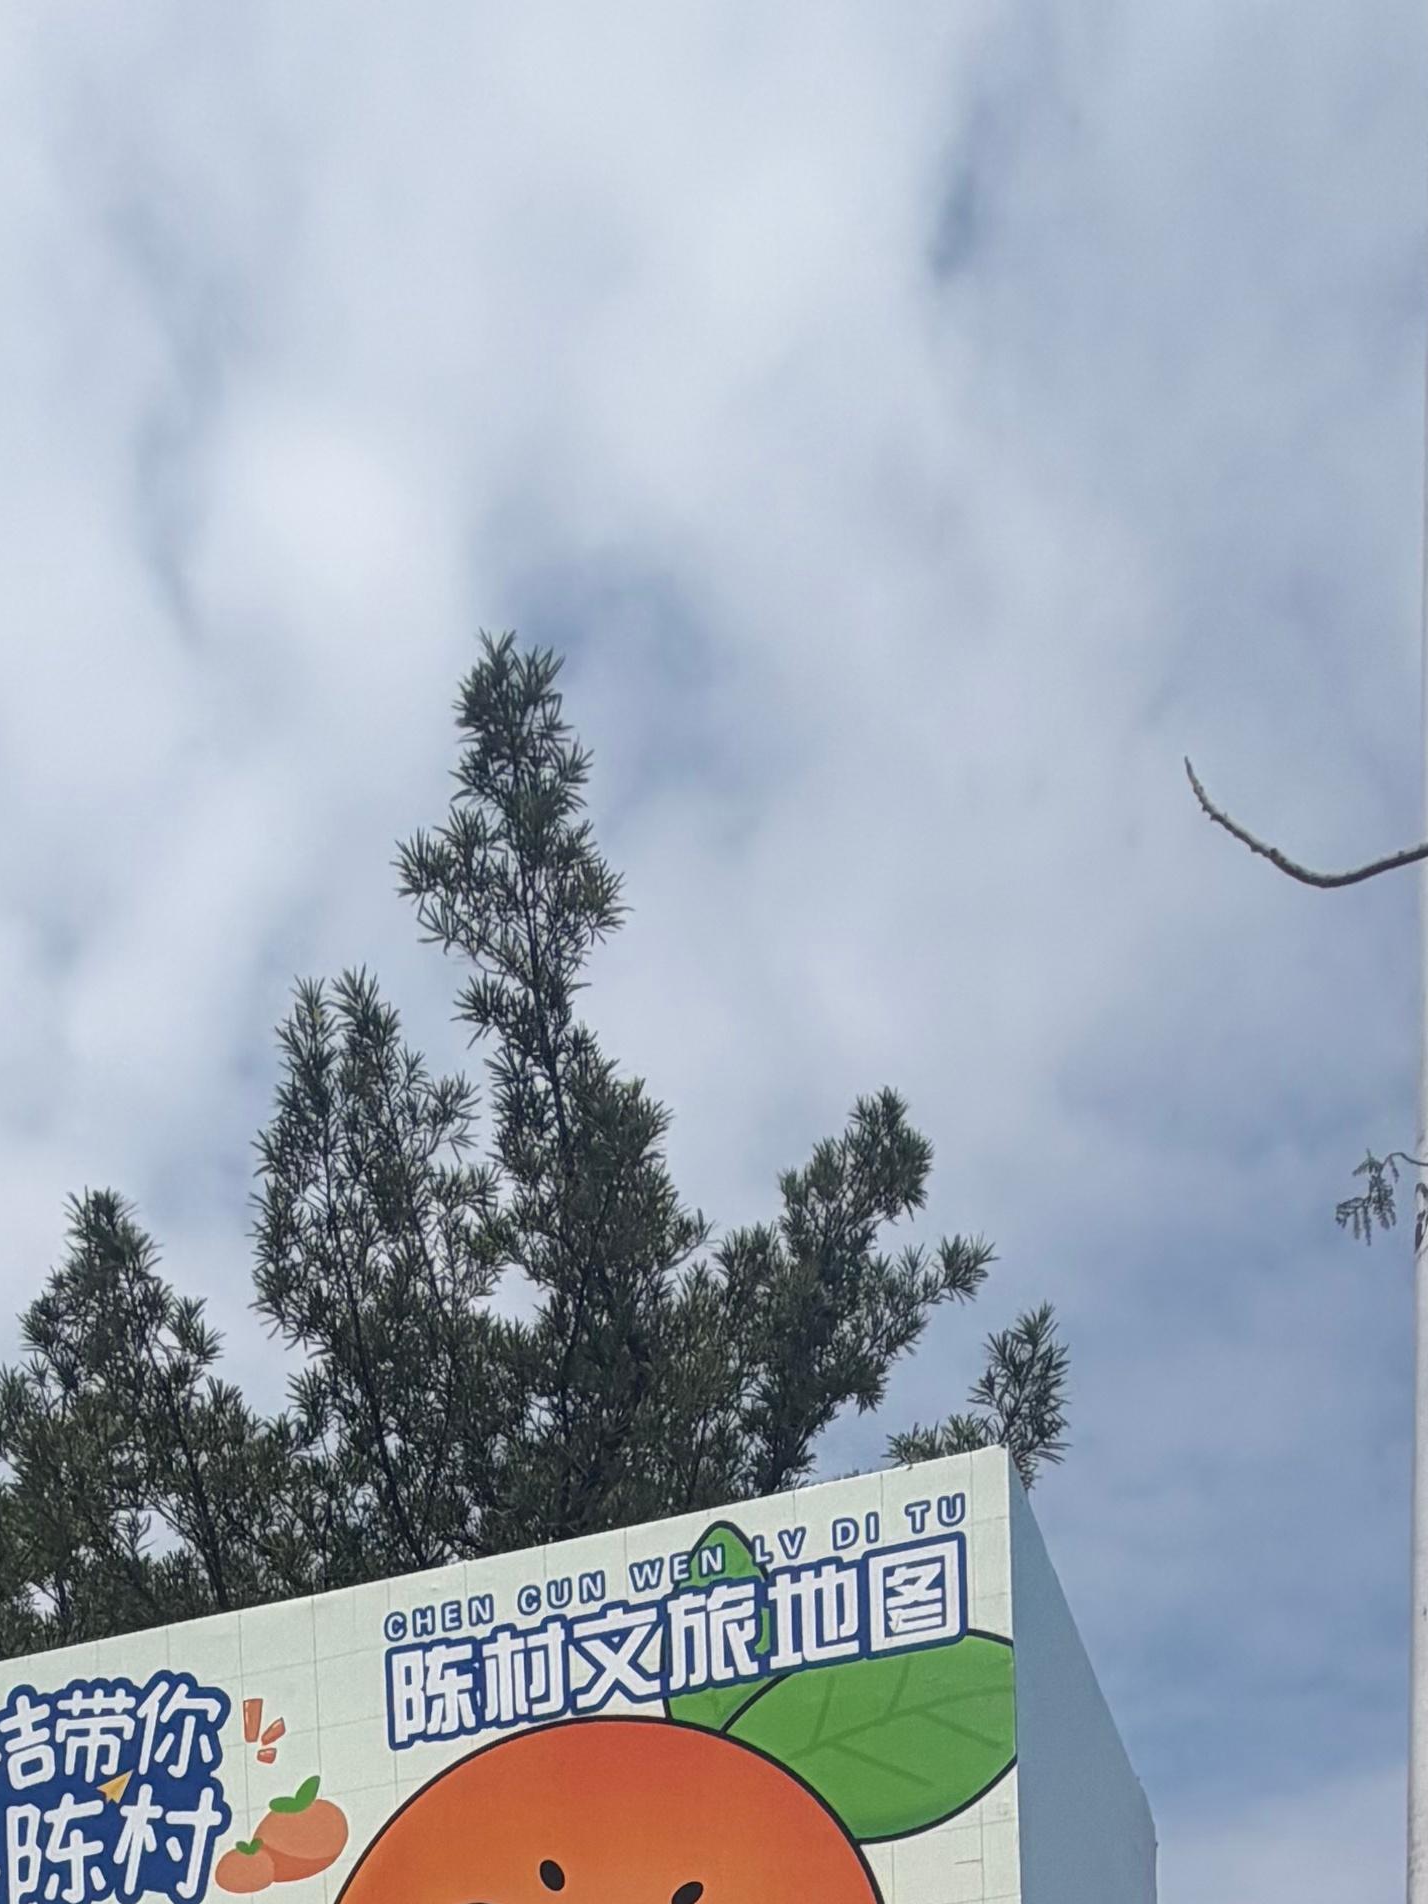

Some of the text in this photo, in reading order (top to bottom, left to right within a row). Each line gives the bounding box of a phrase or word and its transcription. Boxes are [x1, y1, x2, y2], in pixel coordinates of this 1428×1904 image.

[385, 1494, 965, 1641] CHEN CUN WEN LV DI TU
[389, 1536, 965, 1746] 陈村文旅地图
